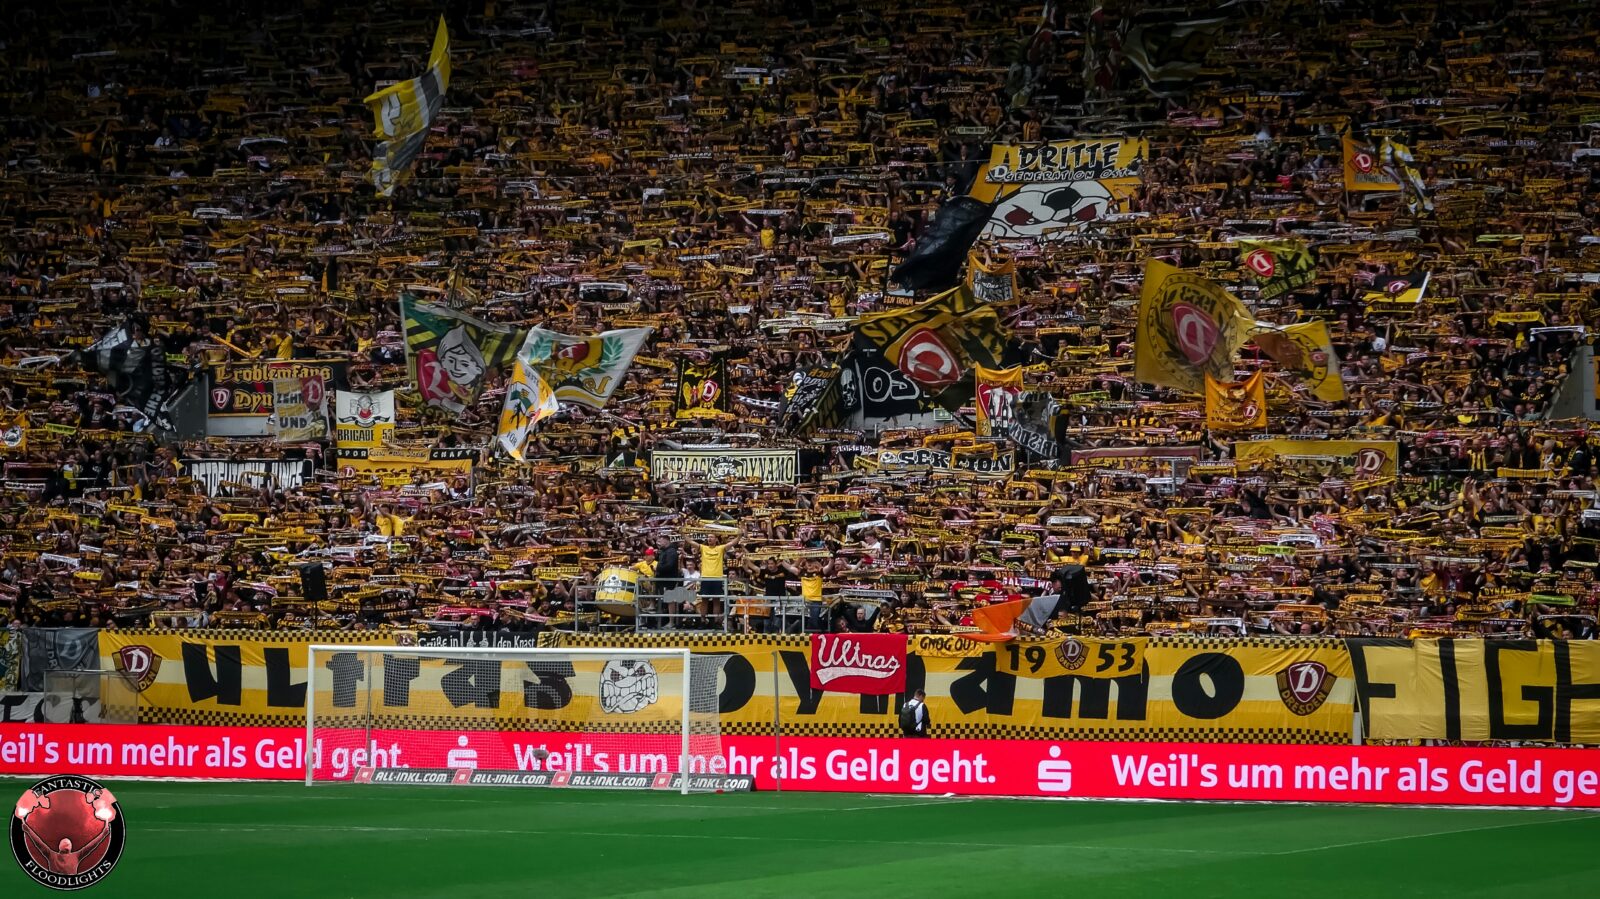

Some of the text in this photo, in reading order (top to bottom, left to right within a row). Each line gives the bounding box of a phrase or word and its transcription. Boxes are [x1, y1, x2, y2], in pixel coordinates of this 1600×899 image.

[1017, 143, 1120, 170] DRITTE
[1006, 170, 1095, 181] GENERATION
[233, 389, 274, 413] Dyn
[279, 416, 310, 432] UND
[337, 427, 375, 443] BRIGADE
[818, 633, 902, 672] Ultras
[1005, 643, 1136, 676] 19 53
[1280, 688, 1328, 716] DRESDEN
[0, 732, 409, 777] eil's um mehr als Geld geht.
[374, 771, 447, 784] ALL-INKL.COM
[472, 773, 547, 786] ALL-INKL.COM
[513, 743, 997, 796] Weil's um mehr als Geld geht.
[571, 774, 647, 788] ALL-INKL.COM
[1111, 753, 1219, 787] Weil's
[1228, 763, 1284, 789] um
[1294, 757, 1391, 792] mehr
[1397, 758, 1449, 792] als
[1459, 760, 1542, 794] Geld
